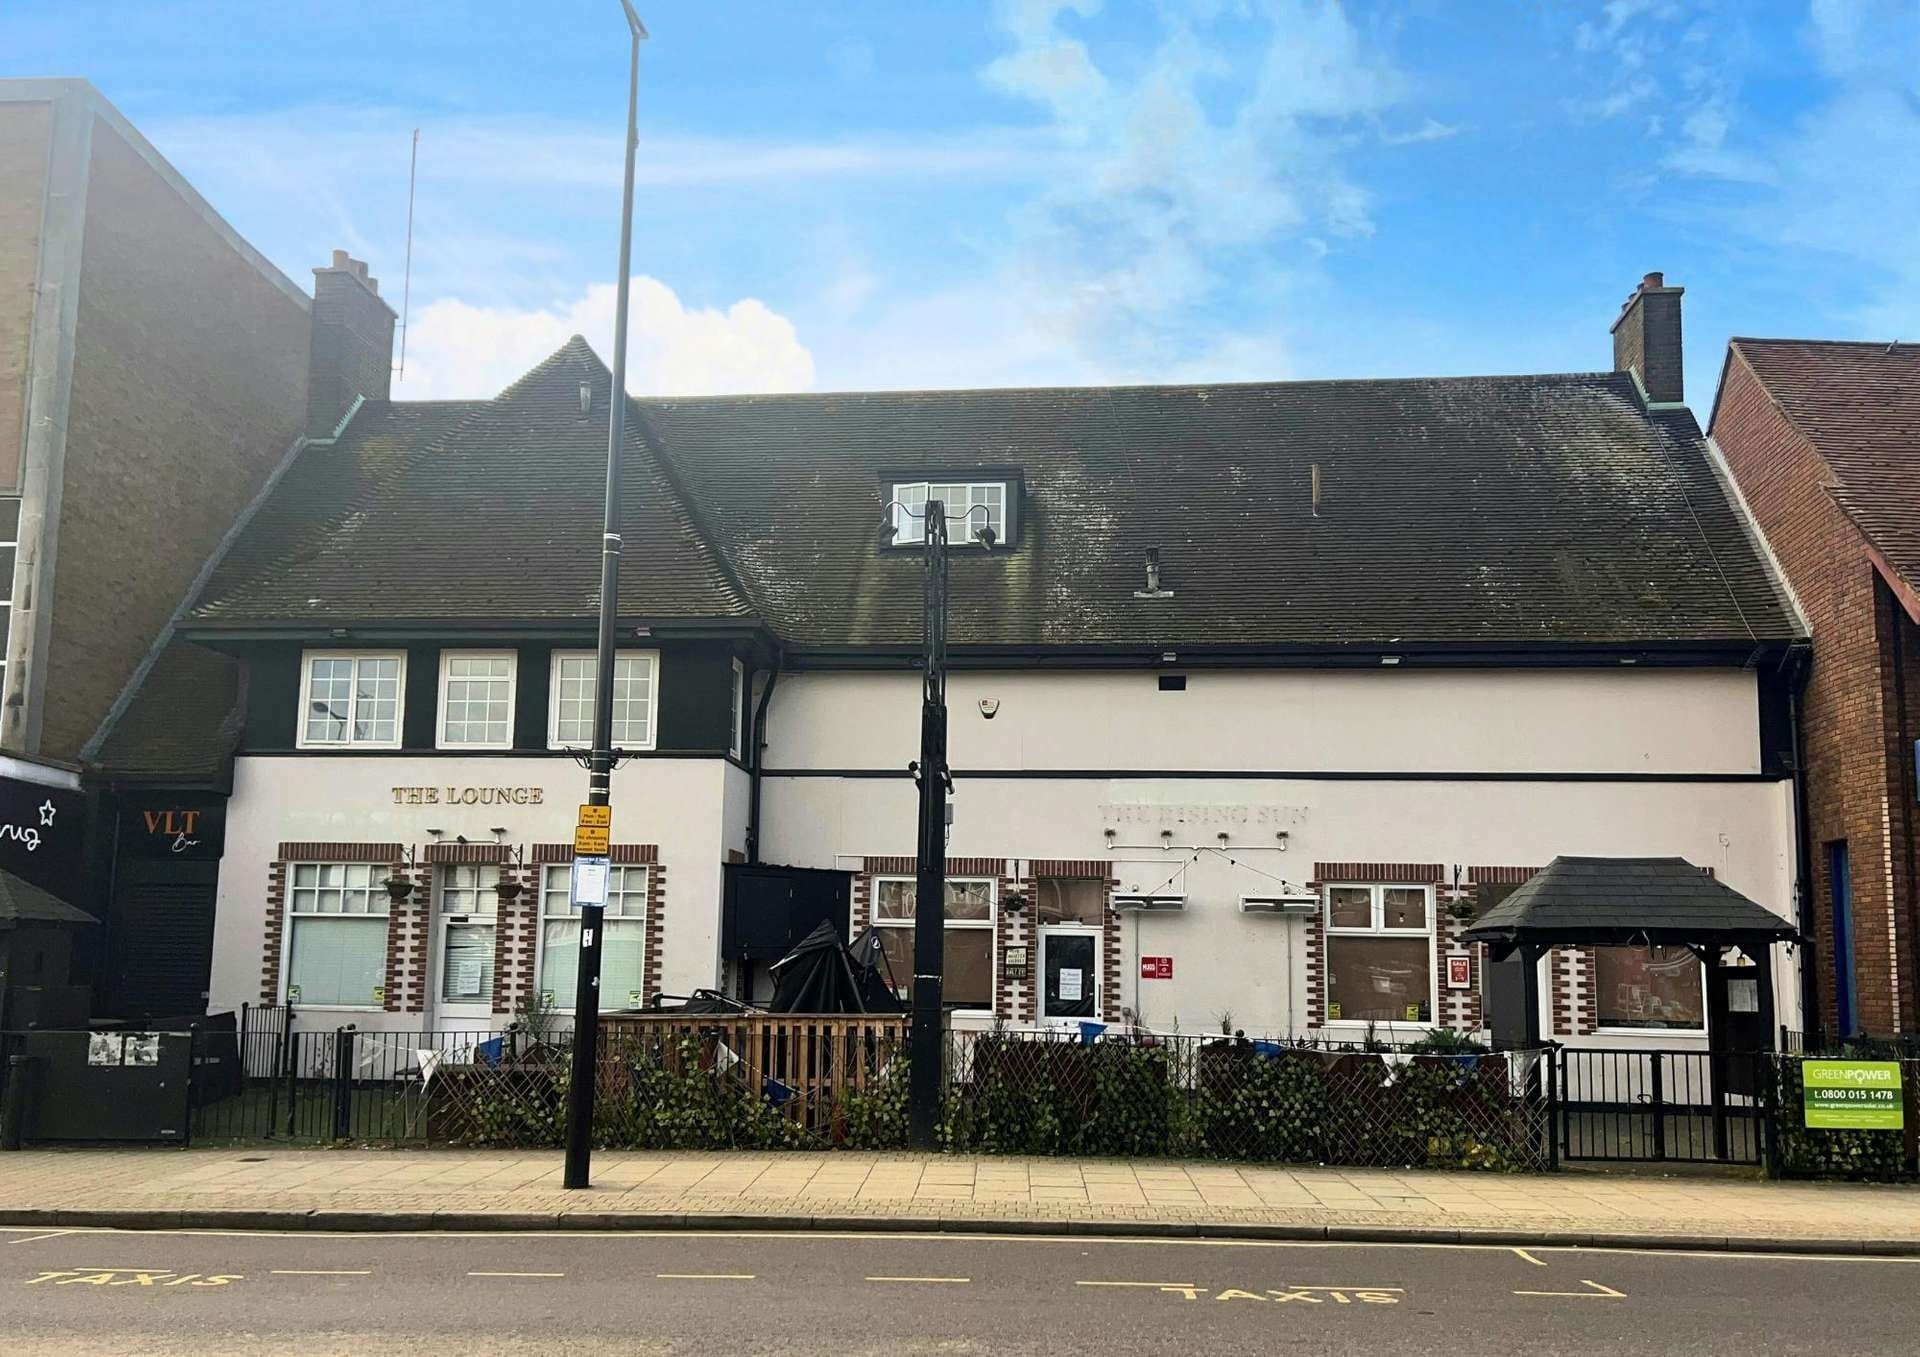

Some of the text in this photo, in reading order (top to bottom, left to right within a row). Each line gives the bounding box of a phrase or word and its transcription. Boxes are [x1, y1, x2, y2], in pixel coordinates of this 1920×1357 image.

[392, 786, 545, 805] THE LOUNGE
[143, 810, 200, 835] VLT
[1812, 1069, 1891, 1085] GREENPOWER
[1848, 1089, 1867, 1100] 015
[1870, 1090, 1894, 1100] 1478
[25, 1271, 244, 1286] TAXIS
[1160, 1286, 1401, 1304] TAXIS
